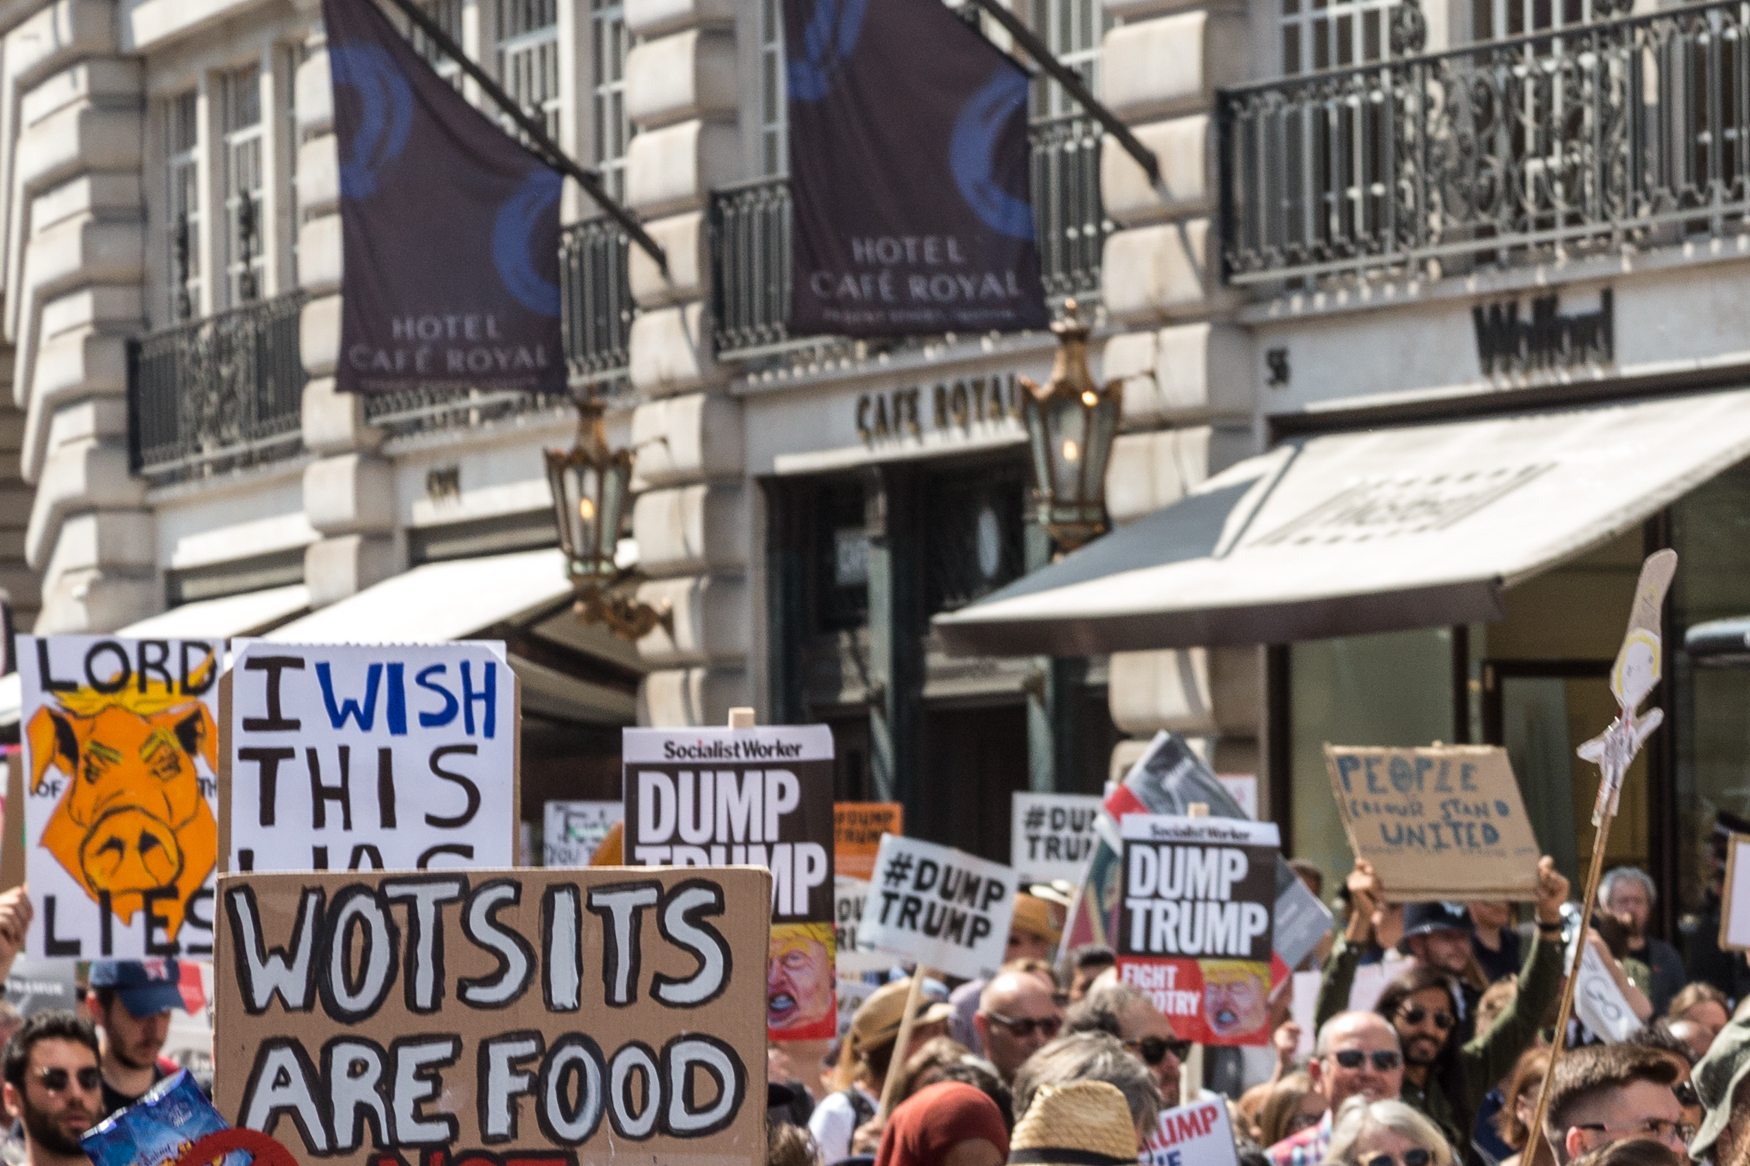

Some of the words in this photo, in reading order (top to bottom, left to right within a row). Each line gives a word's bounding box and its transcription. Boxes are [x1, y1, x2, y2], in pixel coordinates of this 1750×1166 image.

[852, 237, 965, 264] HOTEL
[810, 270, 896, 300] CAFÉ
[908, 270, 1022, 300] ROYAL
[392, 315, 500, 341] HOTEL
[349, 343, 432, 373] CAFÉ
[447, 344, 549, 373] ROYAL
[37, 638, 217, 696] LORD
[242, 656, 305, 731] I
[315, 660, 496, 738] WISH
[664, 740, 740, 760] Socialist
[741, 740, 803, 758] Worker
[1336, 754, 1477, 794] PEOPLE
[238, 744, 482, 830] THIS
[638, 769, 800, 844] DUMP
[1380, 821, 1499, 849] UNITED
[883, 853, 1005, 912] #DUMP
[1128, 844, 1248, 900] DUMP
[43, 889, 215, 957] LIES
[879, 892, 991, 948] TRUMP
[1125, 899, 1269, 955] TRUMP
[225, 880, 731, 1022] WOTSITS
[237, 1033, 462, 1155] ARE
[478, 1030, 747, 1146] FOOD
